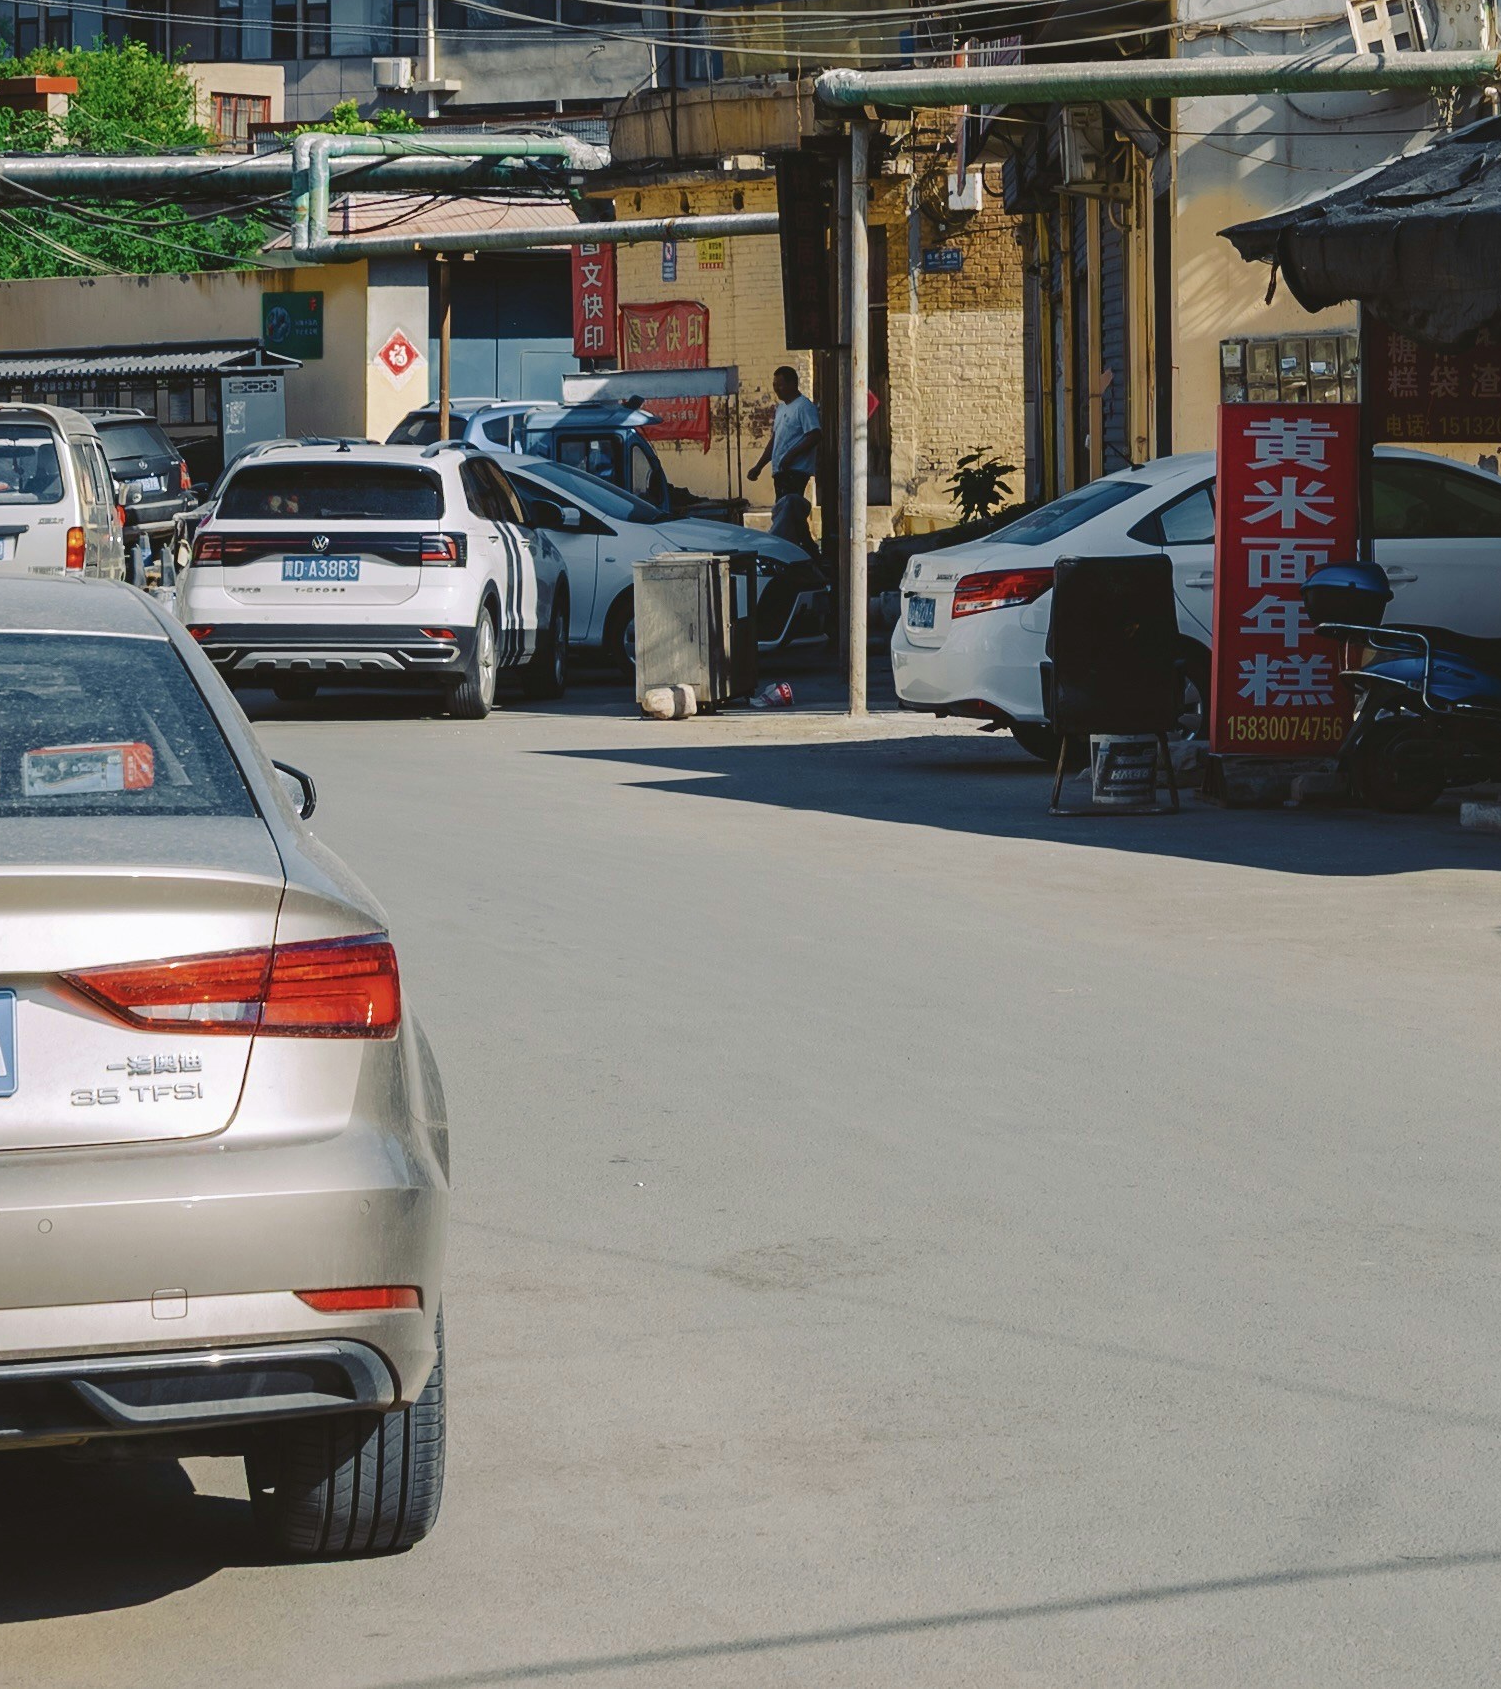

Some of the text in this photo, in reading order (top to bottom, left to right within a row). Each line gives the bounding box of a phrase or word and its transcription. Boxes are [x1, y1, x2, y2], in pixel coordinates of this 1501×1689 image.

[627, 314, 704, 354] 图文快印
[1237, 417, 1339, 706] 黄米面年糕
[1227, 715, 1343, 741] 15830074756
[70, 1082, 203, 1106] 35 TFSI
